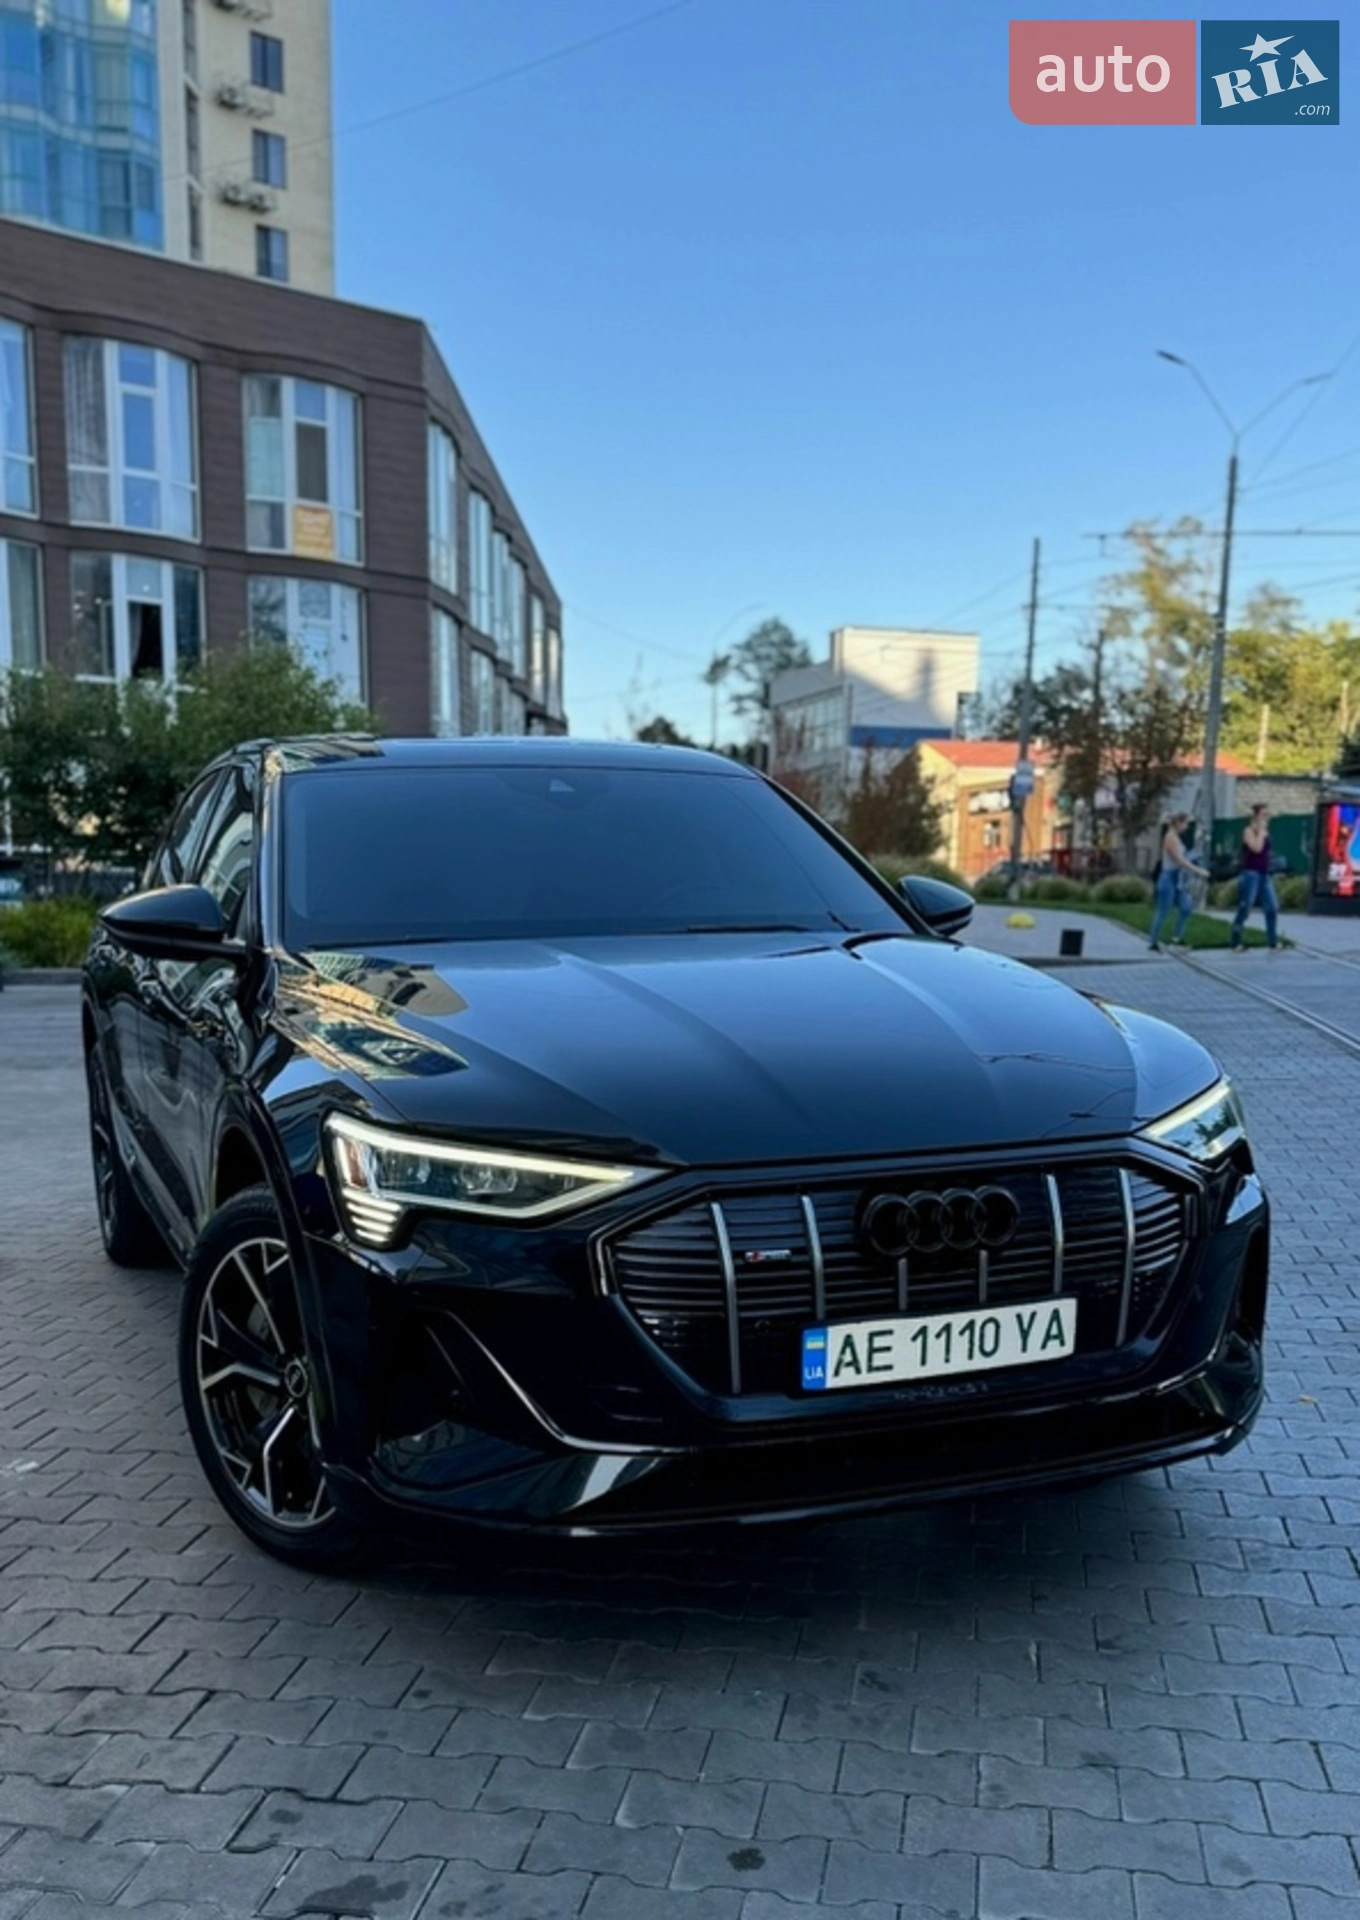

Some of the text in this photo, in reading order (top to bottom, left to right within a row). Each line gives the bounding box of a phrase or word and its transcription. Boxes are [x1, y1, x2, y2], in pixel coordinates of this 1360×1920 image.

[832, 1307, 1066, 1377] AE 1110 YA
[804, 1366, 824, 1380] UA
